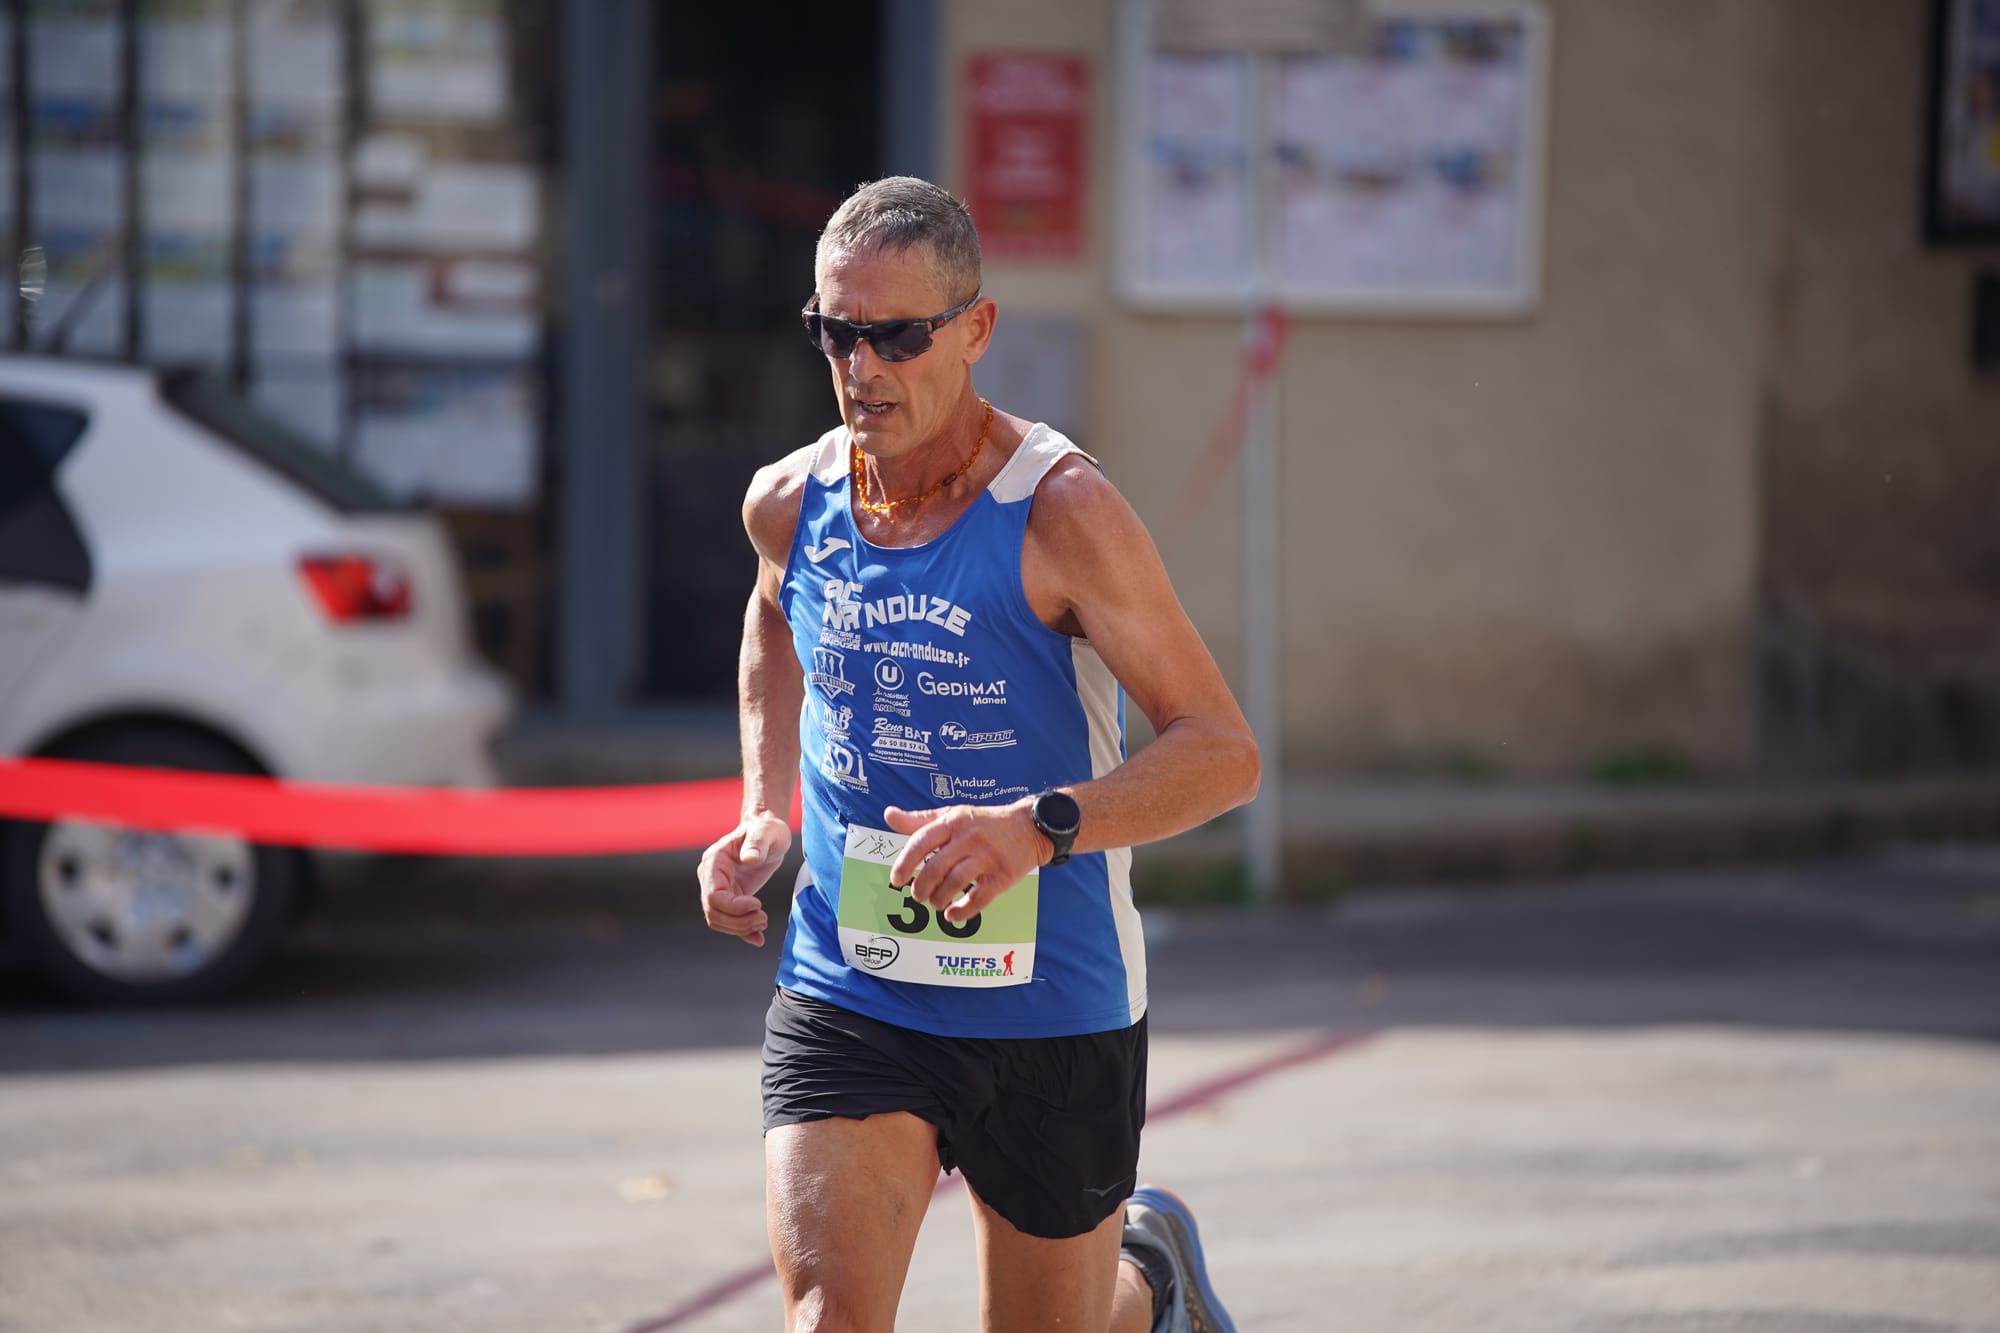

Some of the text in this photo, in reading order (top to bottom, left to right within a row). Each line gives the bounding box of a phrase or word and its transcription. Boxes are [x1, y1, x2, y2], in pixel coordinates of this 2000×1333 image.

[863, 641, 970, 668] www.acn-anduze.fr
[882, 665, 898, 683] U
[973, 696, 1007, 706] Manen
[904, 726, 932, 744] BAT
[941, 725, 1015, 744] KP SPORT
[954, 776, 997, 788] Anduze
[956, 785, 1030, 800] Porte des Cévennes
[855, 944, 893, 960] BFP
[935, 955, 997, 969] TUFF'S
[940, 964, 1003, 977] Aventure
